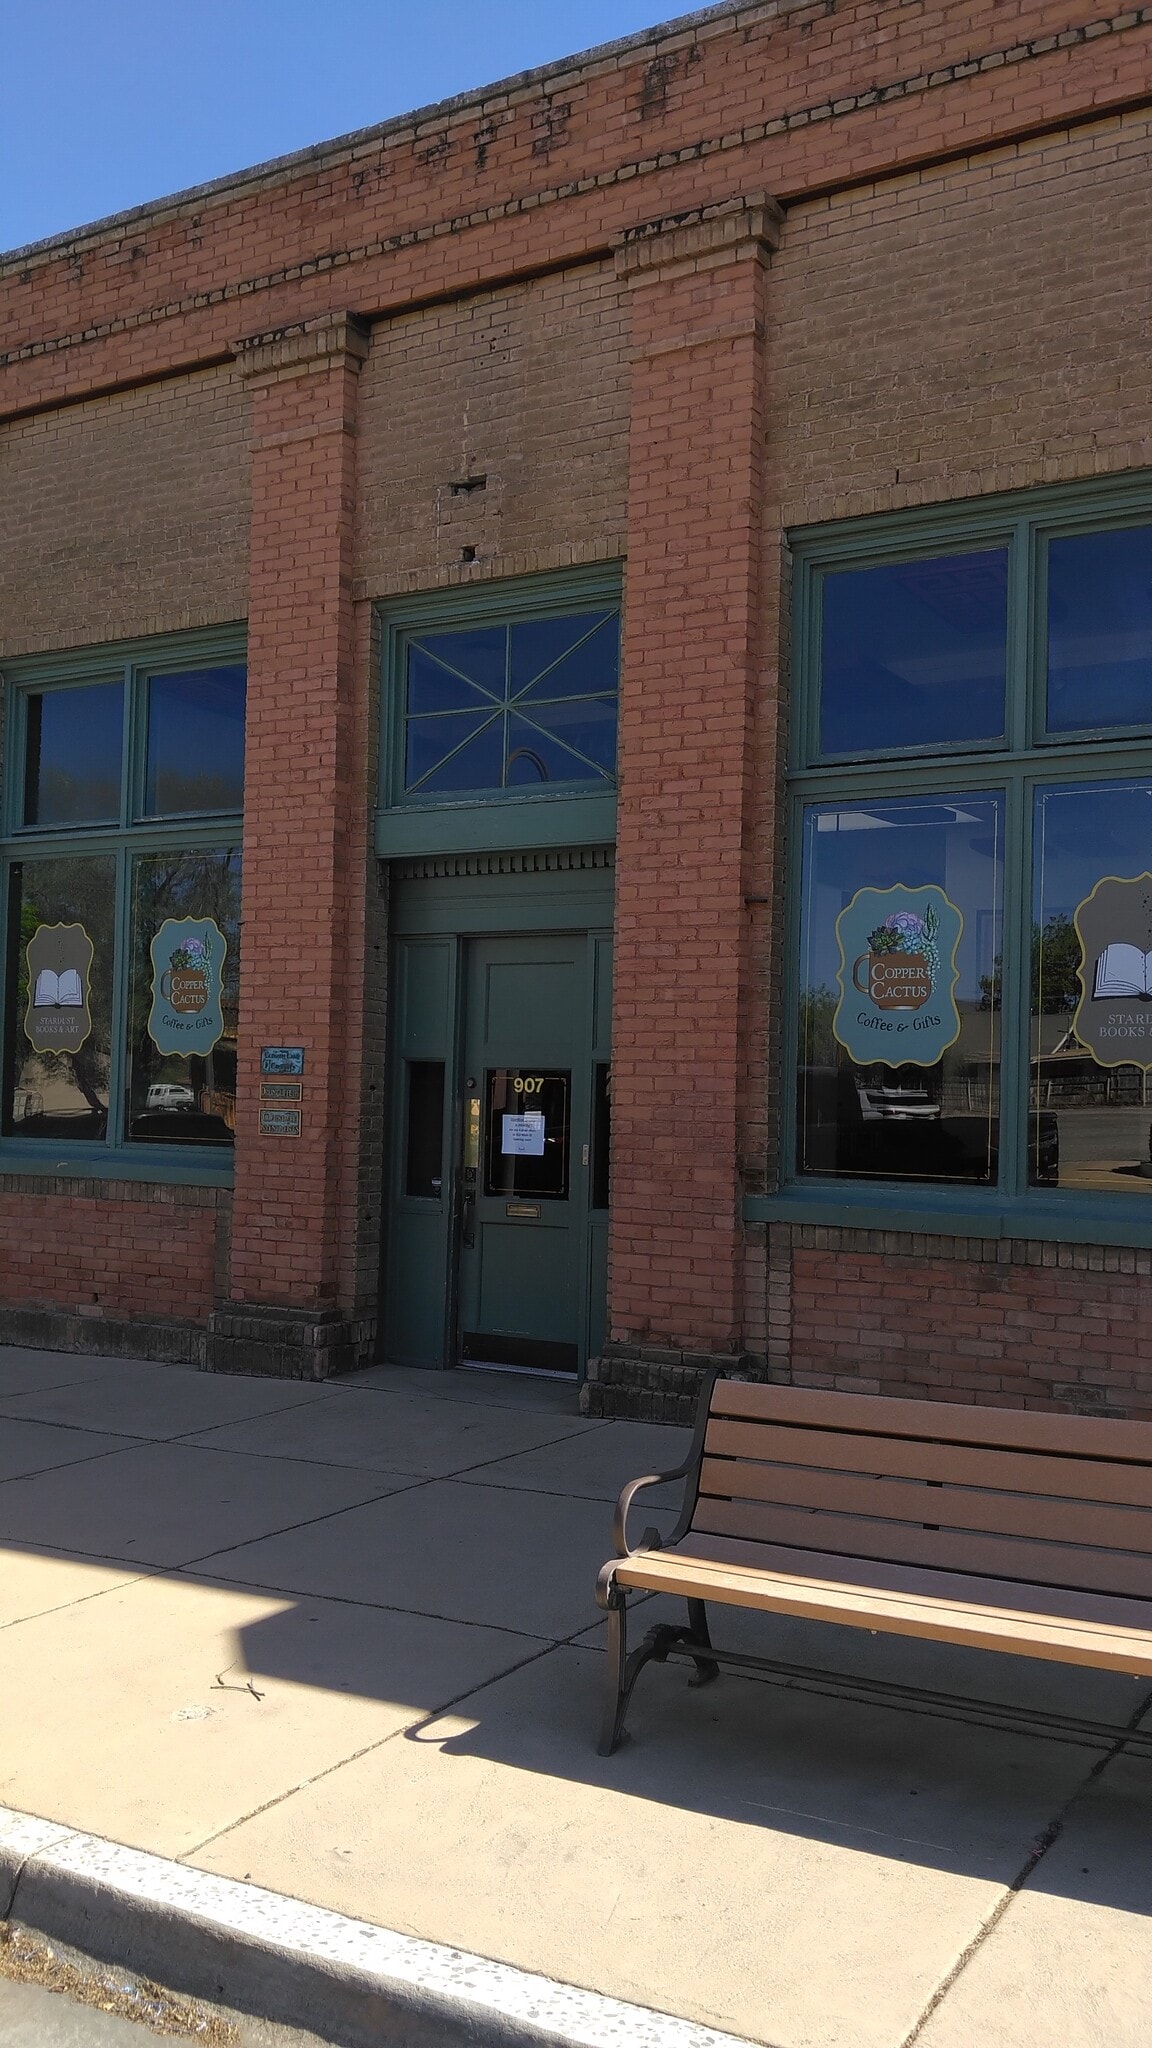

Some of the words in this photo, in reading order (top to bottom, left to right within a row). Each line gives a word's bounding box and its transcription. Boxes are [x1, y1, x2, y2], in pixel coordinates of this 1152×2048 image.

[871, 963, 926, 980] COPPER
[171, 977, 204, 990] COPPER
[870, 981, 927, 999] CACTUS
[171, 991, 205, 1005] CACTUS
[36, 1025, 57, 1033] BOOKS
[65, 1025, 79, 1033] ART
[162, 1015, 184, 1029] Coffee
[195, 1017, 213, 1029] Gifts
[857, 1013, 893, 1031] Coffee
[897, 1023, 908, 1032] &
[913, 1015, 941, 1030] Gifts
[1100, 1026, 1145, 1037] BOOKS
[513, 1077, 544, 1093] 907
